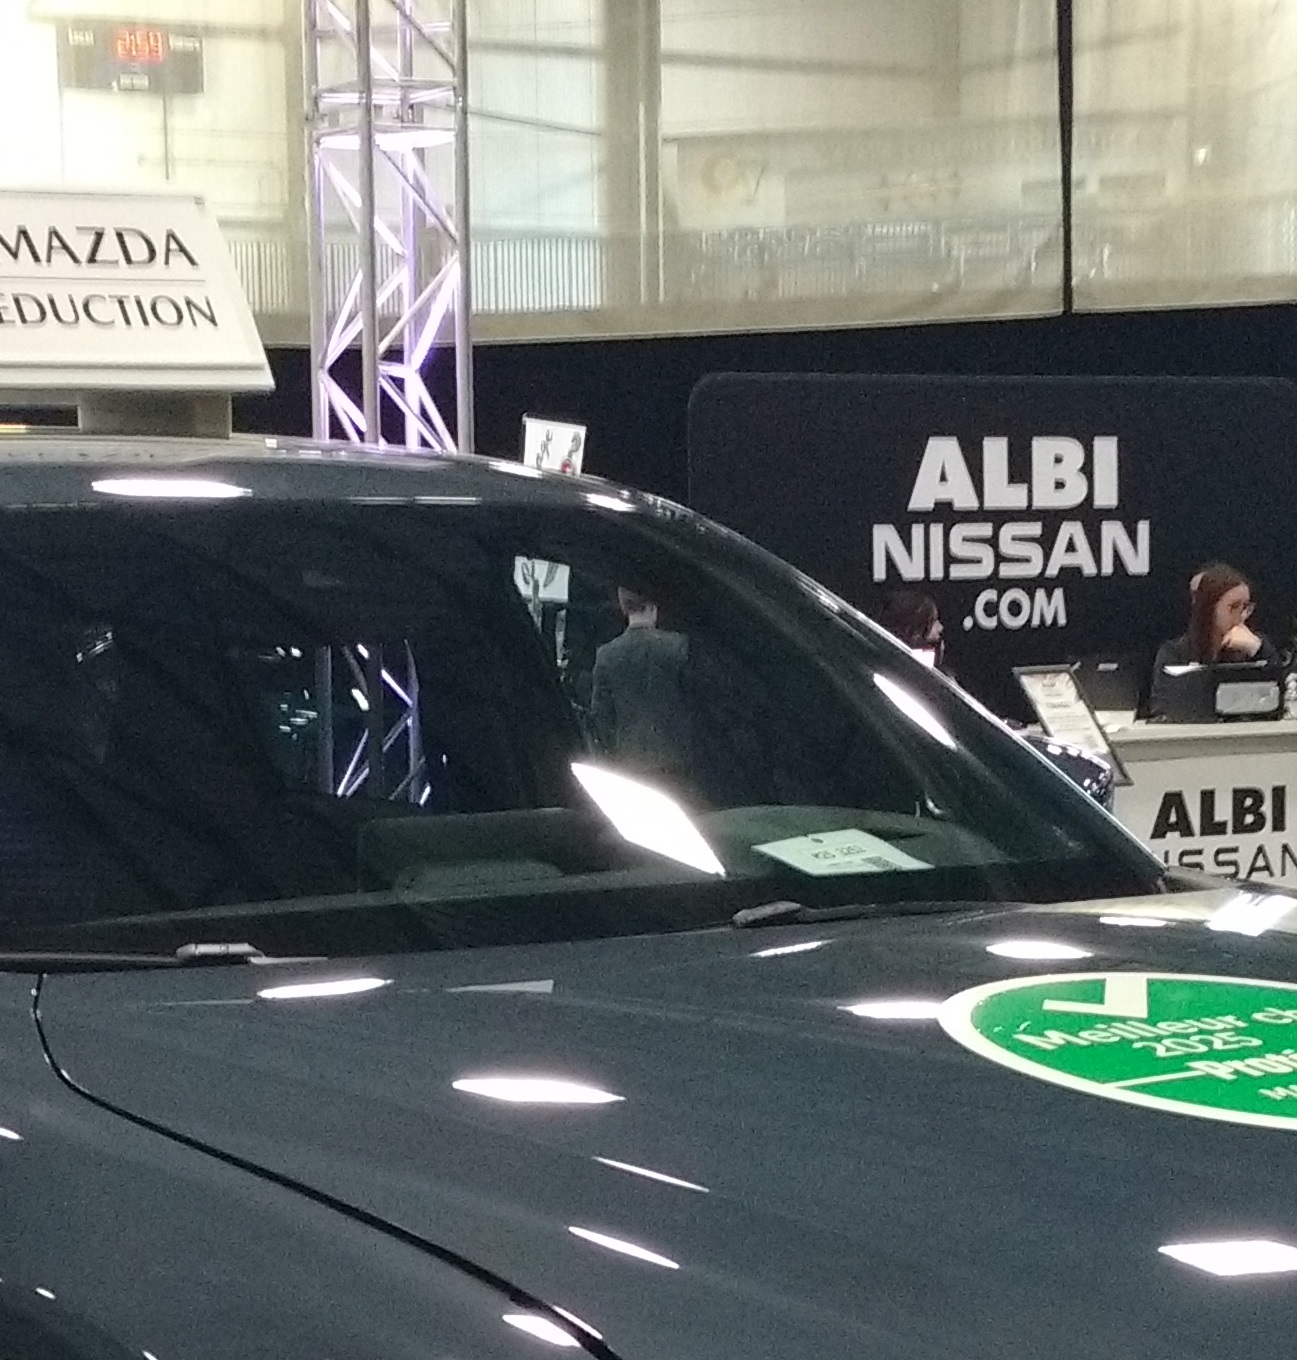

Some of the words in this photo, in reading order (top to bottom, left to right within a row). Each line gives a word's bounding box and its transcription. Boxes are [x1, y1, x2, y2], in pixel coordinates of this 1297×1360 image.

[907, 436, 1119, 511] ALBI
[872, 520, 1150, 582] NISSAN
[963, 587, 1067, 631] .COM
[1150, 785, 1287, 840] ALBI
[1013, 1014, 1249, 1051] Meilleur
[1132, 1031, 1262, 1058] 2025
